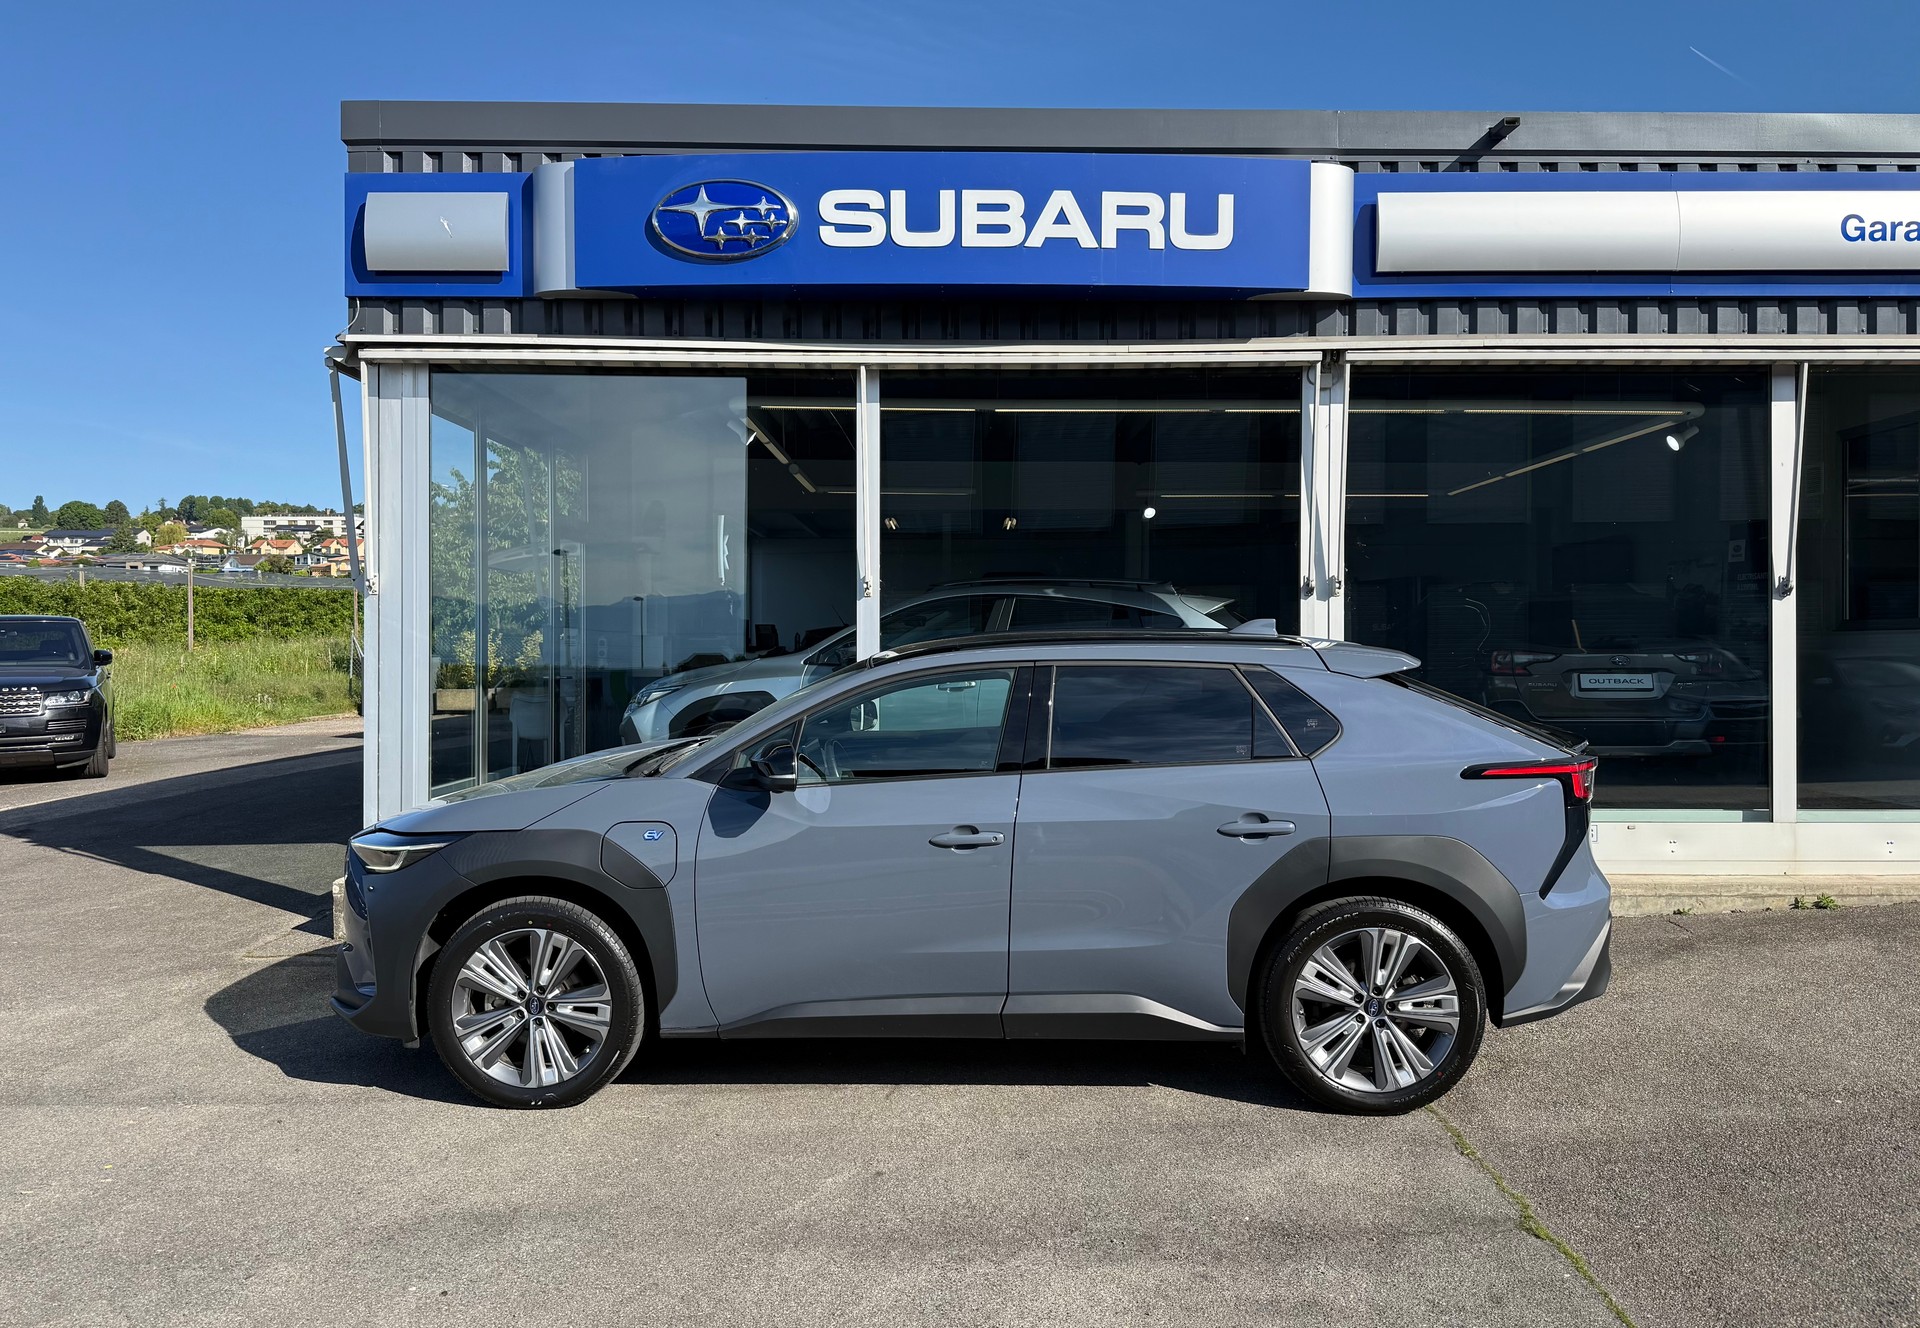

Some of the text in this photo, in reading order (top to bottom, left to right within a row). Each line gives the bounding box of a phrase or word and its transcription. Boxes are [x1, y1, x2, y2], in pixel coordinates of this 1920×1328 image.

[818, 189, 1234, 249] SUBARU
[1840, 213, 1920, 242] Gara
[642, 829, 664, 841] EV
